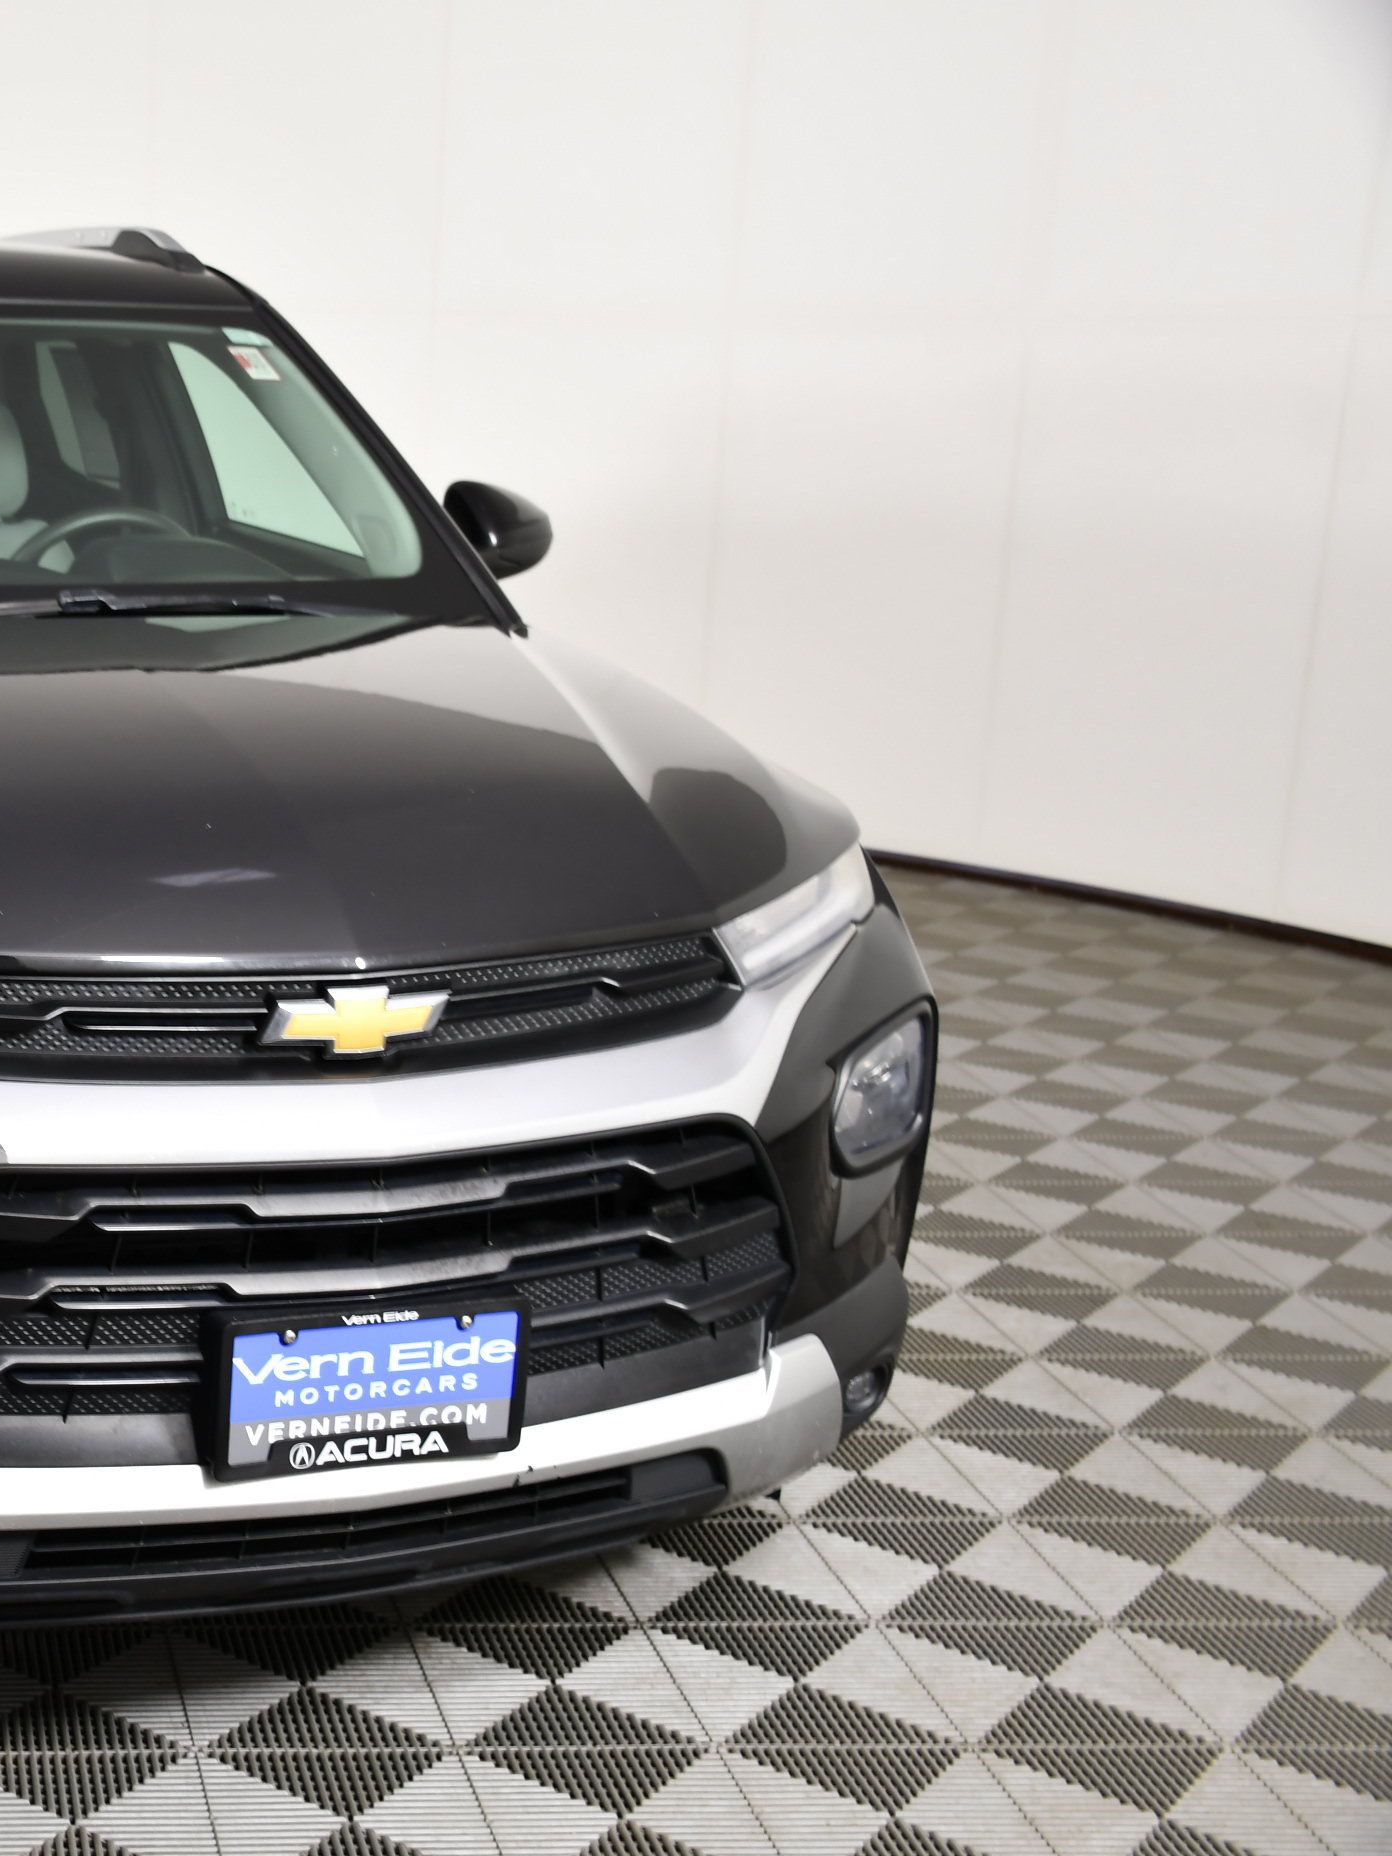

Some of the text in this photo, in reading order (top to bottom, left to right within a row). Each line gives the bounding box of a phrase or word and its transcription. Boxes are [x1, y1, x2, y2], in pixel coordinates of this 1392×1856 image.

[341, 1309, 420, 1327] Vern Eide
[232, 1336, 517, 1385] Vern Eide
[274, 1372, 480, 1408] MOTORCARS
[244, 1402, 488, 1446] VERNEIDE.COM
[315, 1430, 450, 1466] ACURA
